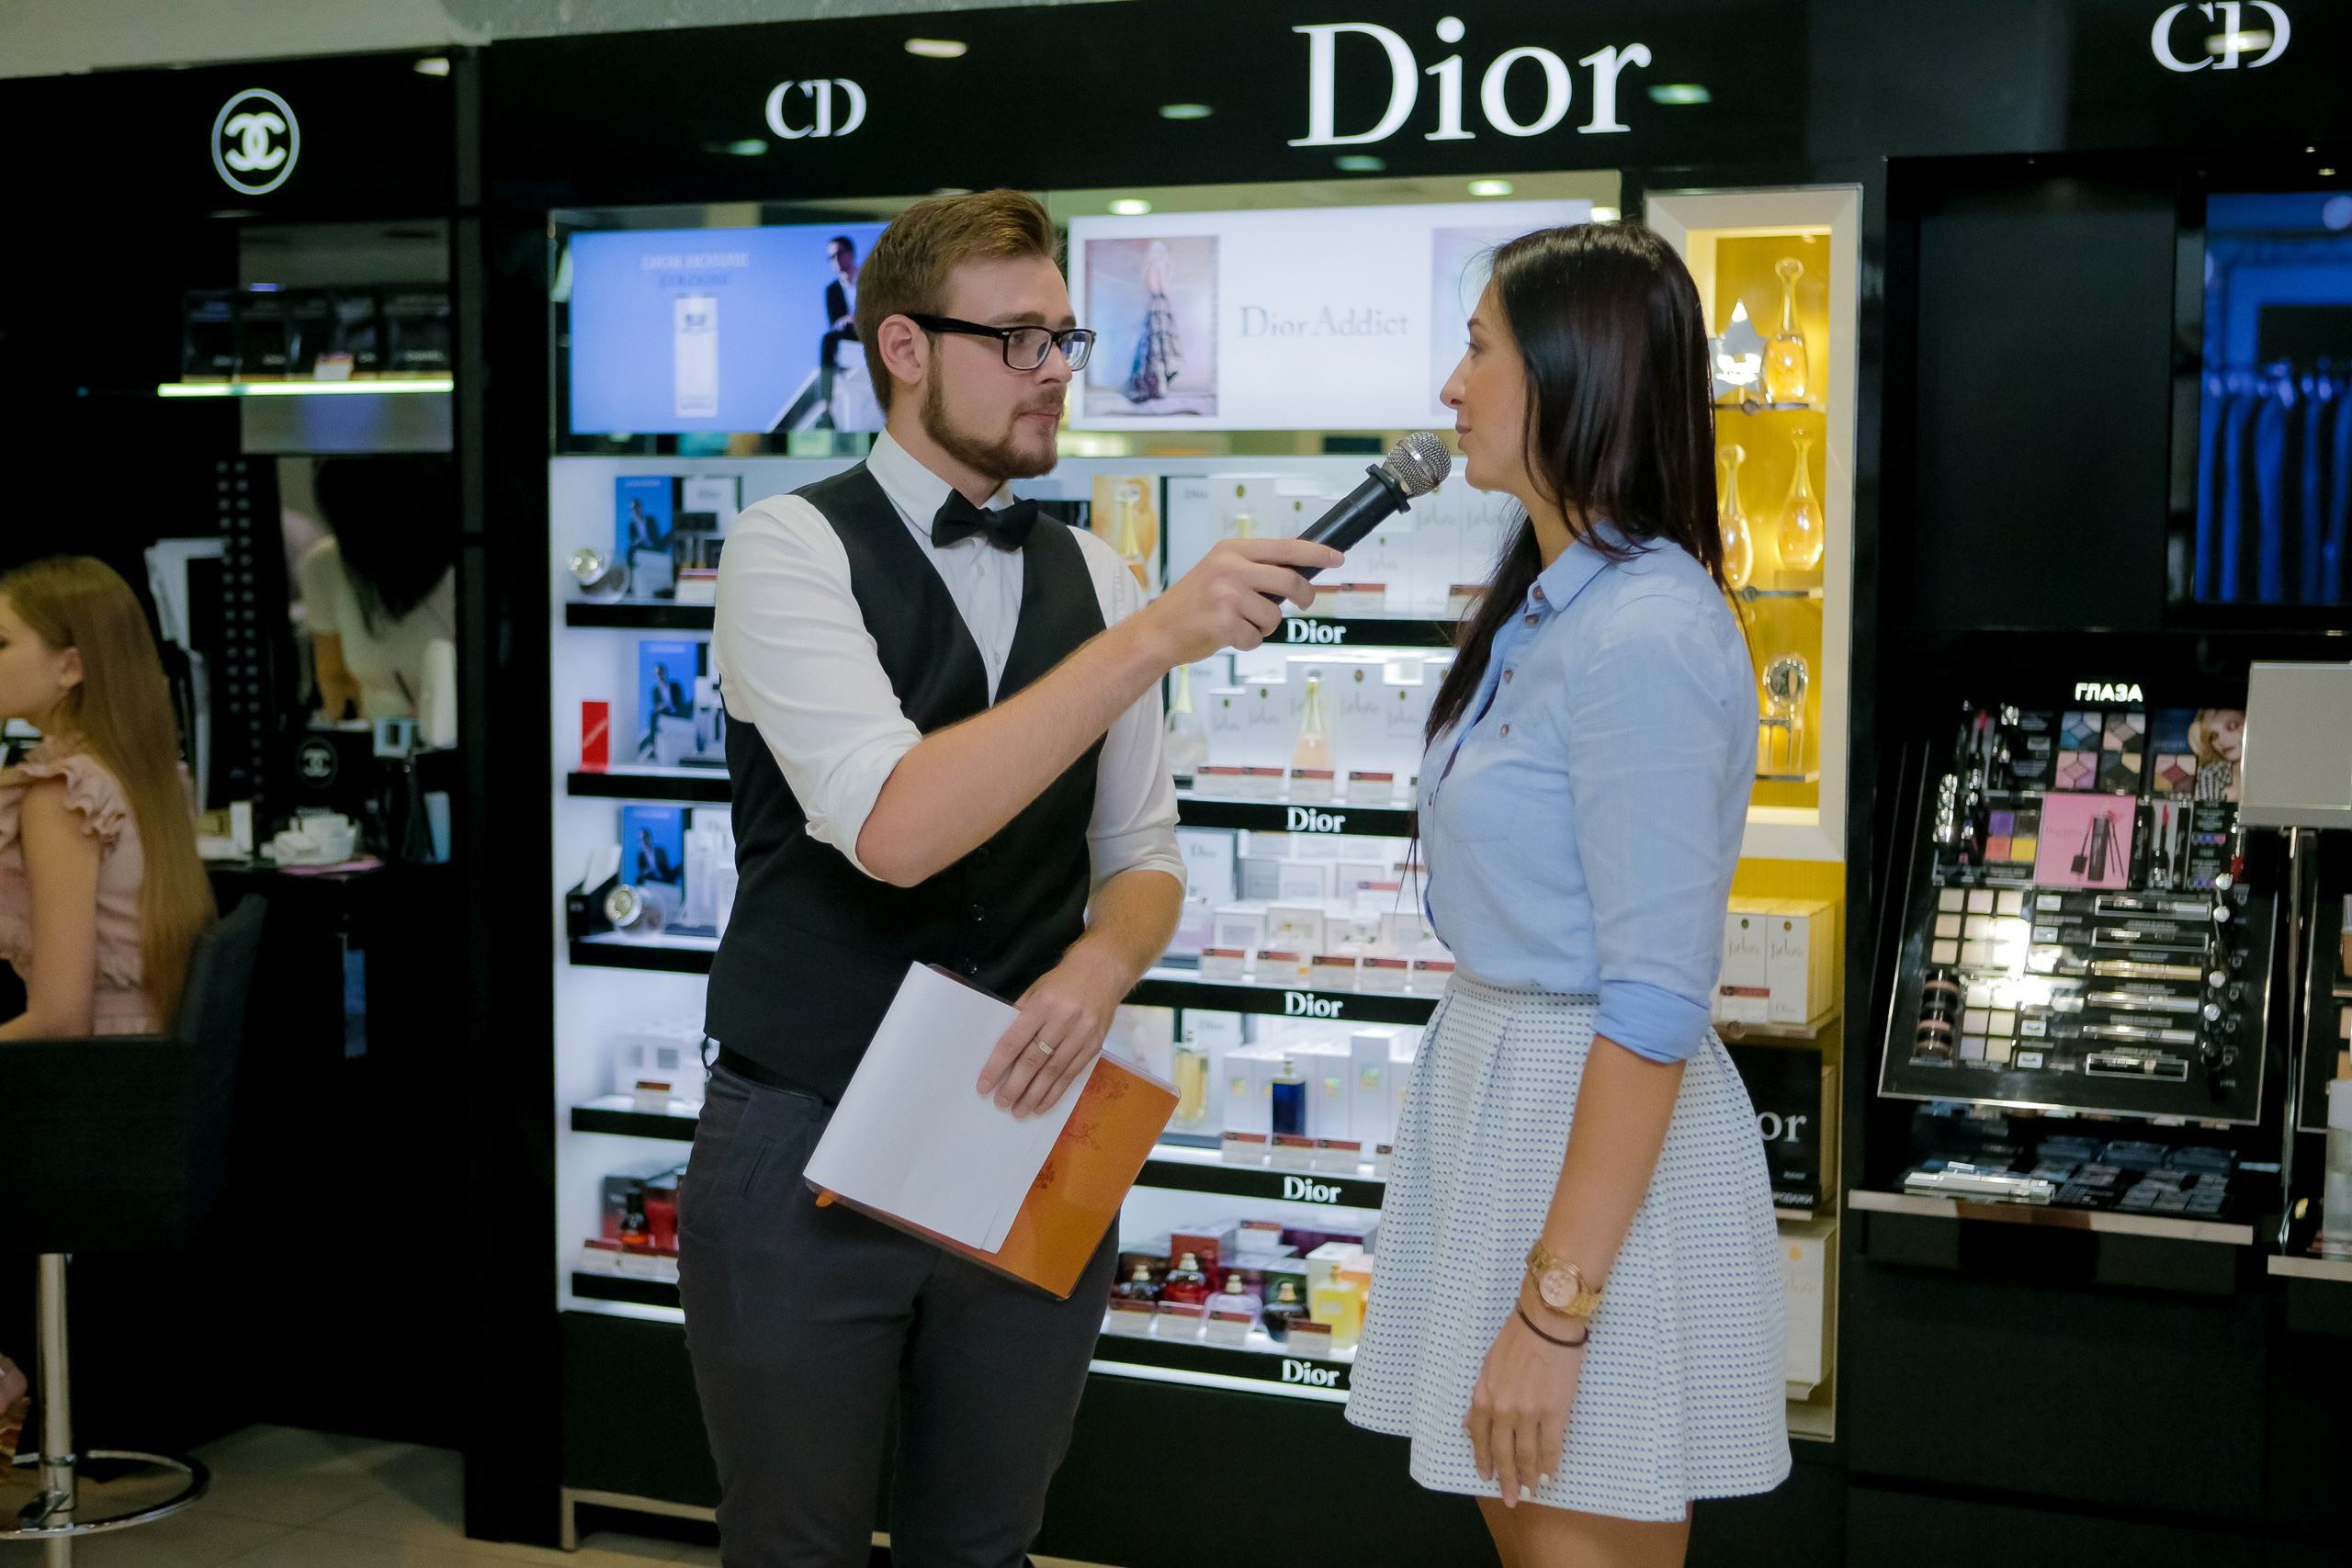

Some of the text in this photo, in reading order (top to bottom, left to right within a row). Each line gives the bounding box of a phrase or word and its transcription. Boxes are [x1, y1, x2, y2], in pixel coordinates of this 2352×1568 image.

[1286, 16, 1653, 147] Dior
[764, 78, 867, 140] CD
[1238, 305, 1411, 338] Dior Addict
[1285, 618, 1348, 644] Dior
[2074, 682, 2144, 704] ГЛАЗА
[1285, 807, 1347, 834] Dior
[1283, 991, 1344, 1019] Dior
[1756, 1111, 1808, 1144] or
[1282, 1176, 1342, 1204] Dior
[1281, 1359, 1340, 1388] Dior
